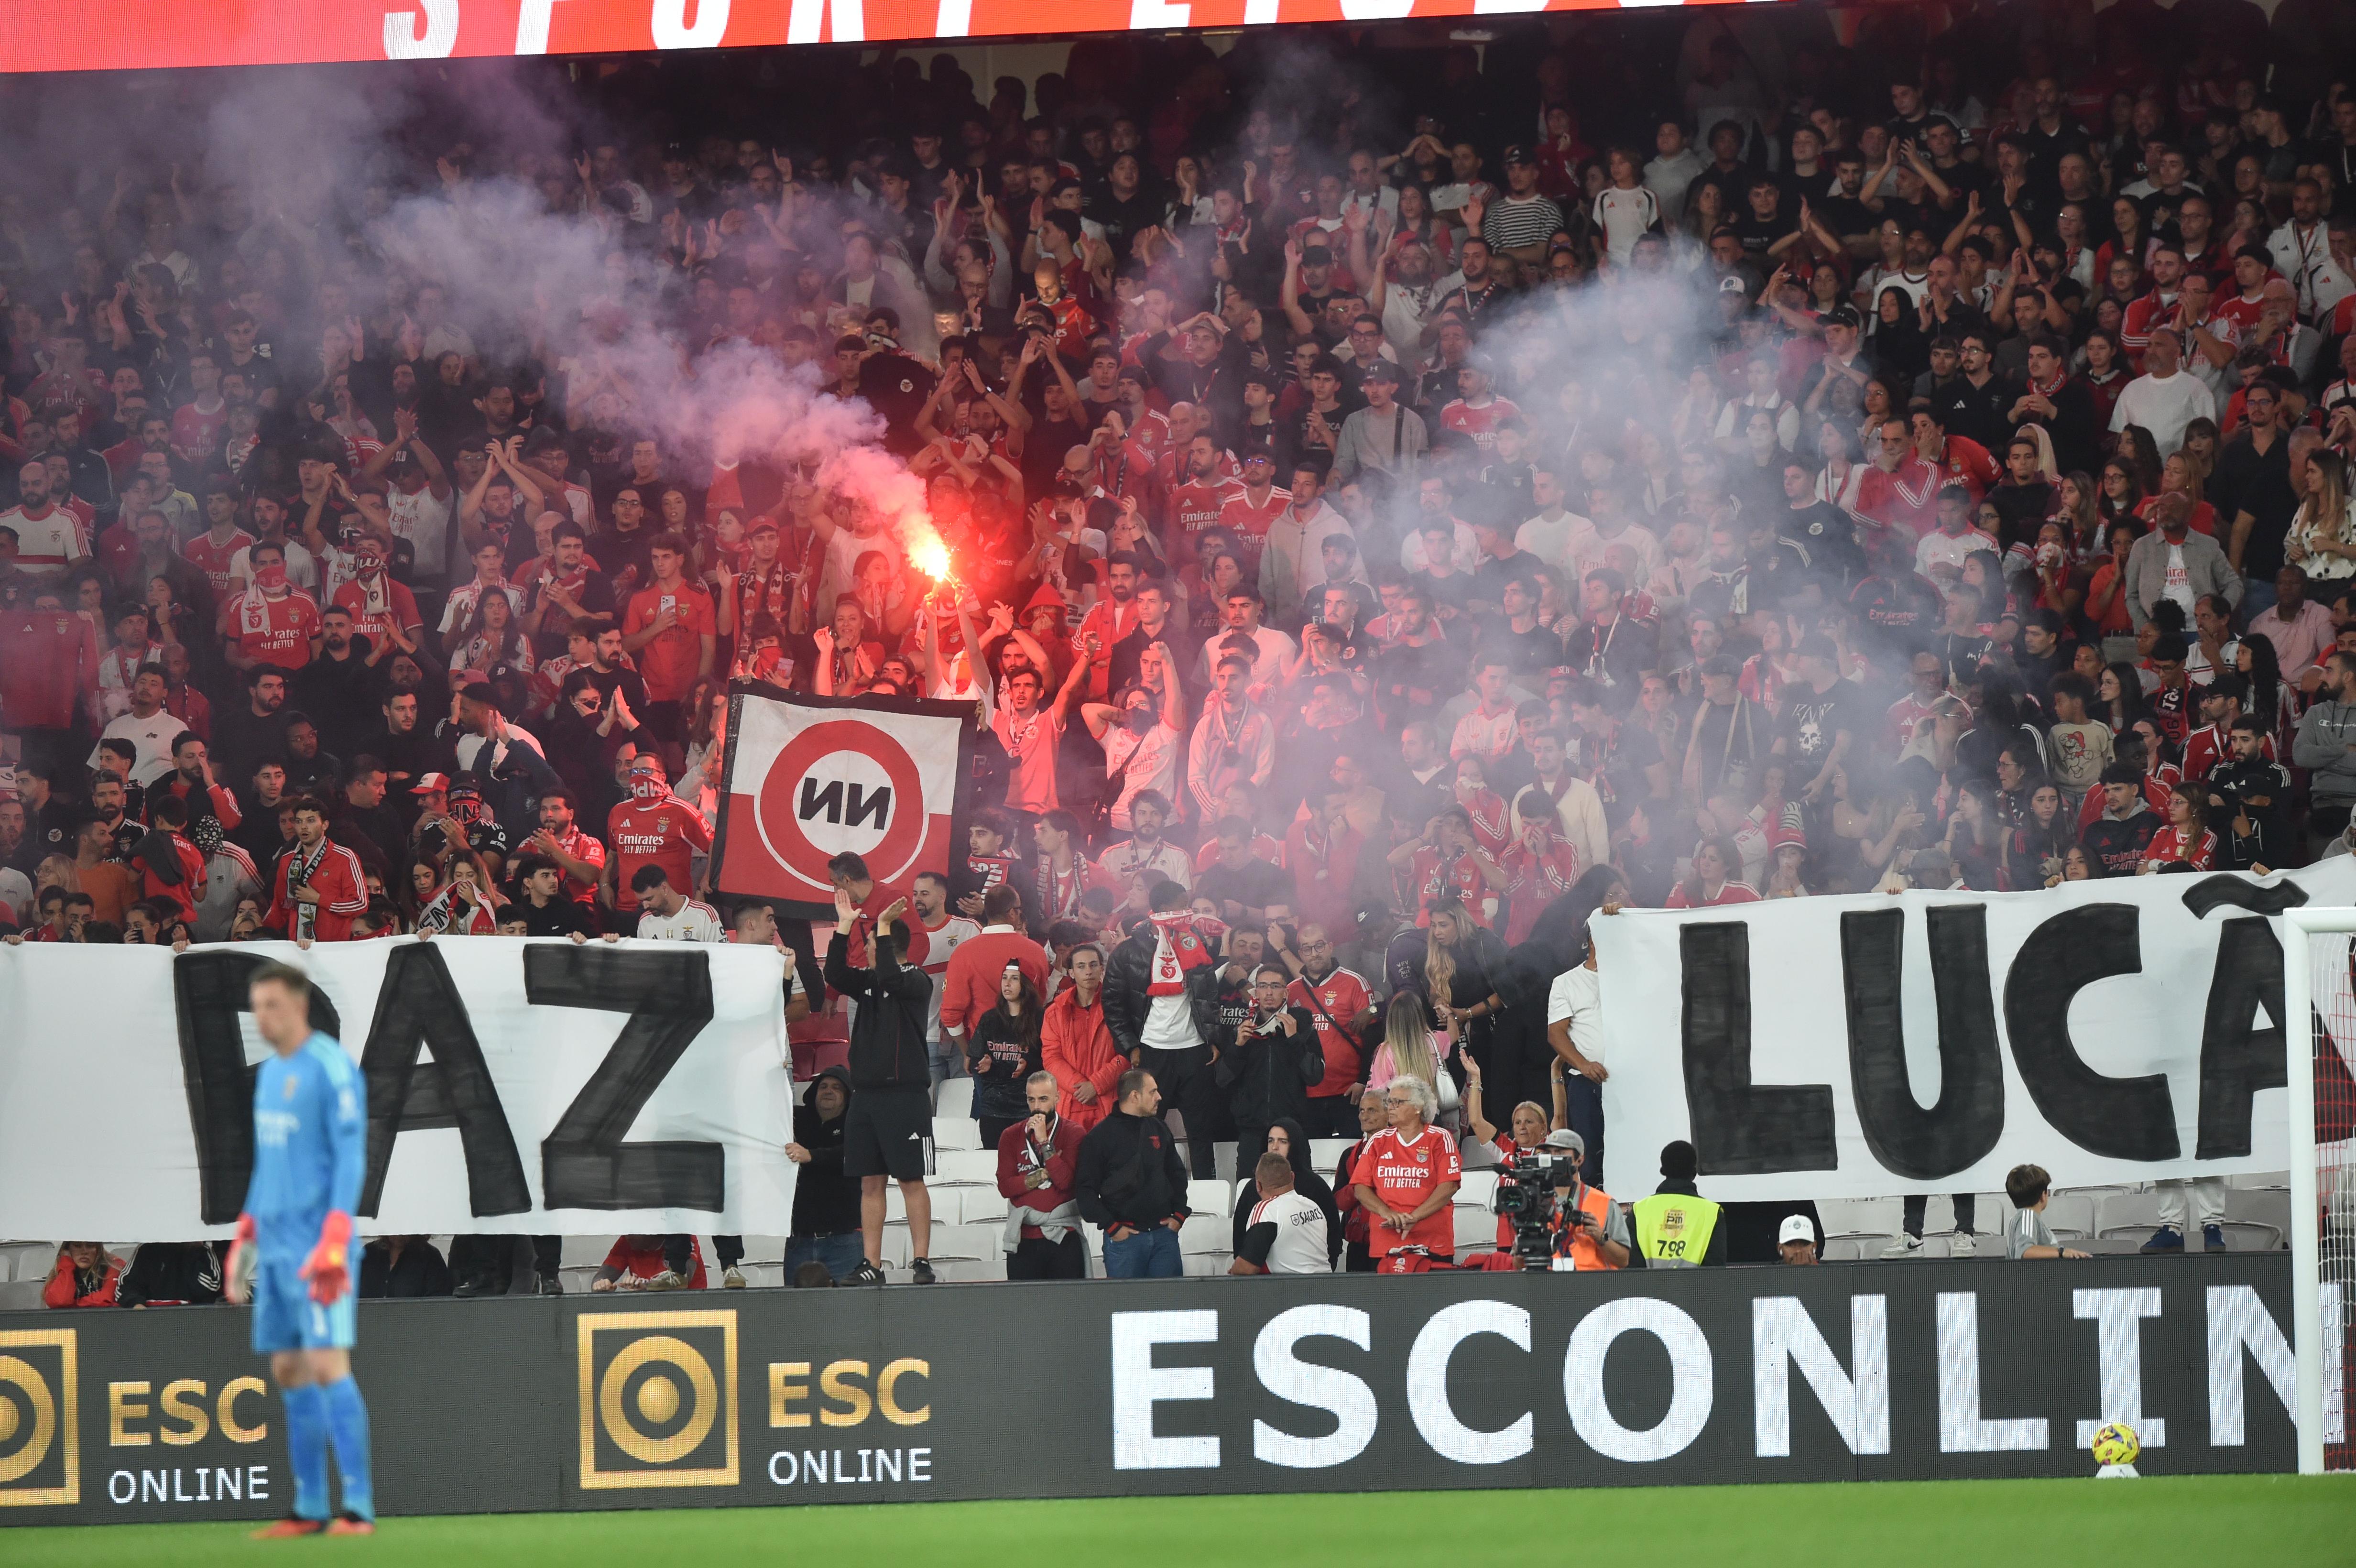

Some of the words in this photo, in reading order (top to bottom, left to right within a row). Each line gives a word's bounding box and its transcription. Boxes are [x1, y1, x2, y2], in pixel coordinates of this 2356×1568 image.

[1181, 511, 1220, 523] Emirate
[273, 639, 294, 649] BETTER
[173, 838, 191, 851] AGRES
[618, 833, 664, 846] Emirates
[624, 845, 634, 854] FLY
[635, 845, 657, 854] BETTER
[1221, 1005, 1250, 1017] irates
[1312, 1023, 1329, 1031] TTER
[1680, 873, 2356, 1180] LUCÃ
[987, 1041, 1029, 1054] Emirates
[174, 941, 725, 1225] PAZ
[1377, 1165, 1429, 1178] Emirates
[1384, 1178, 1395, 1188] FLY
[1396, 1178, 1421, 1188] BETTER
[1299, 1208, 1323, 1225] SAGRES
[1657, 1240, 1686, 1257] 798
[768, 1358, 932, 1428] ESC
[108, 1376, 269, 1447] ESC
[768, 1448, 932, 1485] ONLINE
[108, 1466, 270, 1504] ONLINE
